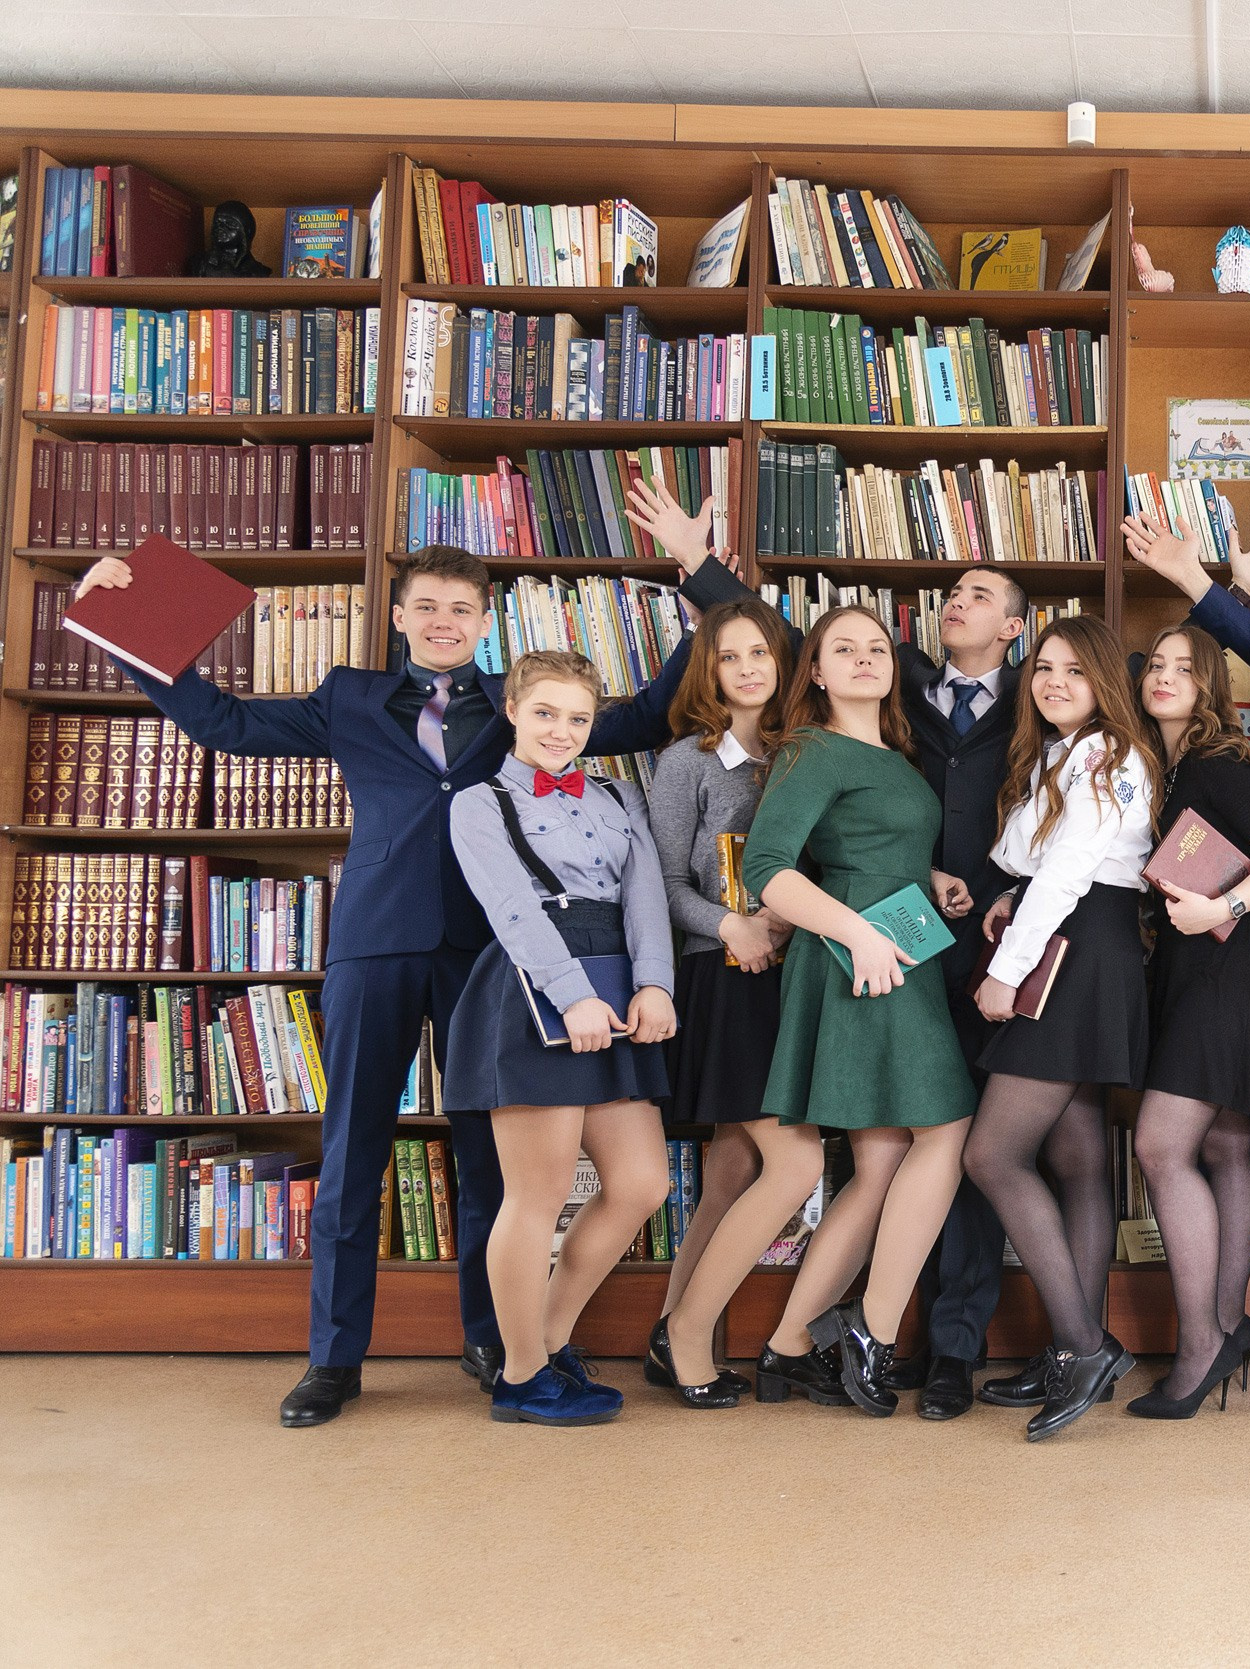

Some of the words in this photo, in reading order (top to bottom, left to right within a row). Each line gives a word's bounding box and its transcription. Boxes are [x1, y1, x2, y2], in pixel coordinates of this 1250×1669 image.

[299, 212, 342, 223] БОЛЬШОЙ
[300, 221, 340, 230] НОВЕЙШИЙ
[627, 213, 654, 237] РУССКИЕ
[296, 236, 344, 244] НЕОБХОДИМЫХ
[306, 242, 333, 251] ЗНАНИЙ
[448, 221, 458, 255] ПАМЯТИ
[467, 221, 477, 255] ПАМЯТИ
[627, 225, 656, 253] ПИСАТЕЛИ
[993, 263, 1036, 275] ПТИЦЫ
[240, 315, 248, 333] ДЕТЕЙ
[625, 314, 633, 351] ТВОРЧЕСТВА
[367, 326, 378, 360] ШКОЛЬНИКА
[406, 316, 419, 361] Космос
[423, 317, 437, 360] Человек
[732, 338, 741, 357] А-Я
[781, 329, 790, 362] РАСТЕНИЙ
[795, 332, 805, 366] РАСТЕНИЙ
[128, 340, 136, 378] ЭКОЛОГИЯ
[271, 329, 279, 389] КОСМОНАВТИКА
[808, 335, 817, 367] РАСТЕНИЙ
[836, 338, 846, 370] РАСТЕНИЙ
[849, 336, 860, 369] РАСТЕНИЙ
[864, 345, 874, 362] мир
[366, 362, 377, 405] СПРАВОЧНИК
[472, 362, 481, 385] РУССКОЙ
[866, 362, 879, 405] открываю
[939, 361, 949, 389] Зоология
[38, 521, 42, 529] 1
[81, 522, 88, 531] 3
[101, 524, 108, 532] 4
[141, 524, 147, 532] 6
[159, 525, 165, 533] 7
[175, 526, 181, 535] 8
[209, 525, 218, 534] 10
[228, 528, 236, 536] 11
[262, 526, 270, 534] 13
[280, 525, 288, 534] 14
[314, 525, 323, 534] 16
[333, 526, 341, 534] 17
[350, 525, 359, 534] 18
[35, 663, 46, 671] 20
[68, 663, 79, 672] 22
[106, 666, 116, 674] 24
[200, 667, 211, 675] 28
[217, 666, 228, 674] 29
[236, 666, 247, 675] 30
[1176, 827, 1204, 863] ПРОШЛОЕ
[1179, 822, 1199, 849] ЖИВОЕ
[1188, 829, 1208, 857] ЗЕМЛИ
[276, 925, 286, 945] ВЕСЬ
[897, 906, 927, 944] ПТИЦЫ
[288, 936, 297, 952] 000
[288, 952, 297, 961] 10
[13, 991, 22, 1027] ШКОЛЬНИКА
[253, 1000, 266, 1020] мир
[294, 1001, 312, 1043] ЭНЦИКЛОПЕДИЯ
[11, 1028, 20, 1072] ЭНЦИКЛОПЕДИЯ
[216, 1042, 225, 1064] ВСЕХ
[235, 1012, 250, 1037] КТО
[243, 1040, 256, 1072] ЕСТЬ
[254, 1022, 273, 1070] Подводный
[47, 1052, 56, 1091] МУДРЕЦОВ
[219, 1065, 227, 1083] ОБО
[295, 1052, 312, 1095] ЕСТЕСТВОЗНАНИЕ
[9, 1073, 18, 1093] НОВАЯ
[25, 1072, 33, 1108] БОЛЬШАЯ
[31, 1078, 39, 1101] КНИГА
[219, 1083, 229, 1100] ВСЁ
[43, 1092, 54, 1109] 100
[59, 1137, 67, 1177] ТВОРЧЕСТВА
[104, 1157, 112, 1197] ДОШКОЛЯТ
[167, 1144, 175, 1197] ШКОЛЬНИКА
[8, 1185, 16, 1207] ВСЕХ
[57, 1178, 65, 1203] ПРАВДА
[8, 1207, 16, 1226] ОБО
[104, 1198, 112, 1213] ДЛЯ
[143, 1169, 153, 1242] ХРЕСТОМАТИЯ
[190, 1201, 200, 1255] КОМПЬЮТЕР
[56, 1231, 64, 1250] ИВАН
